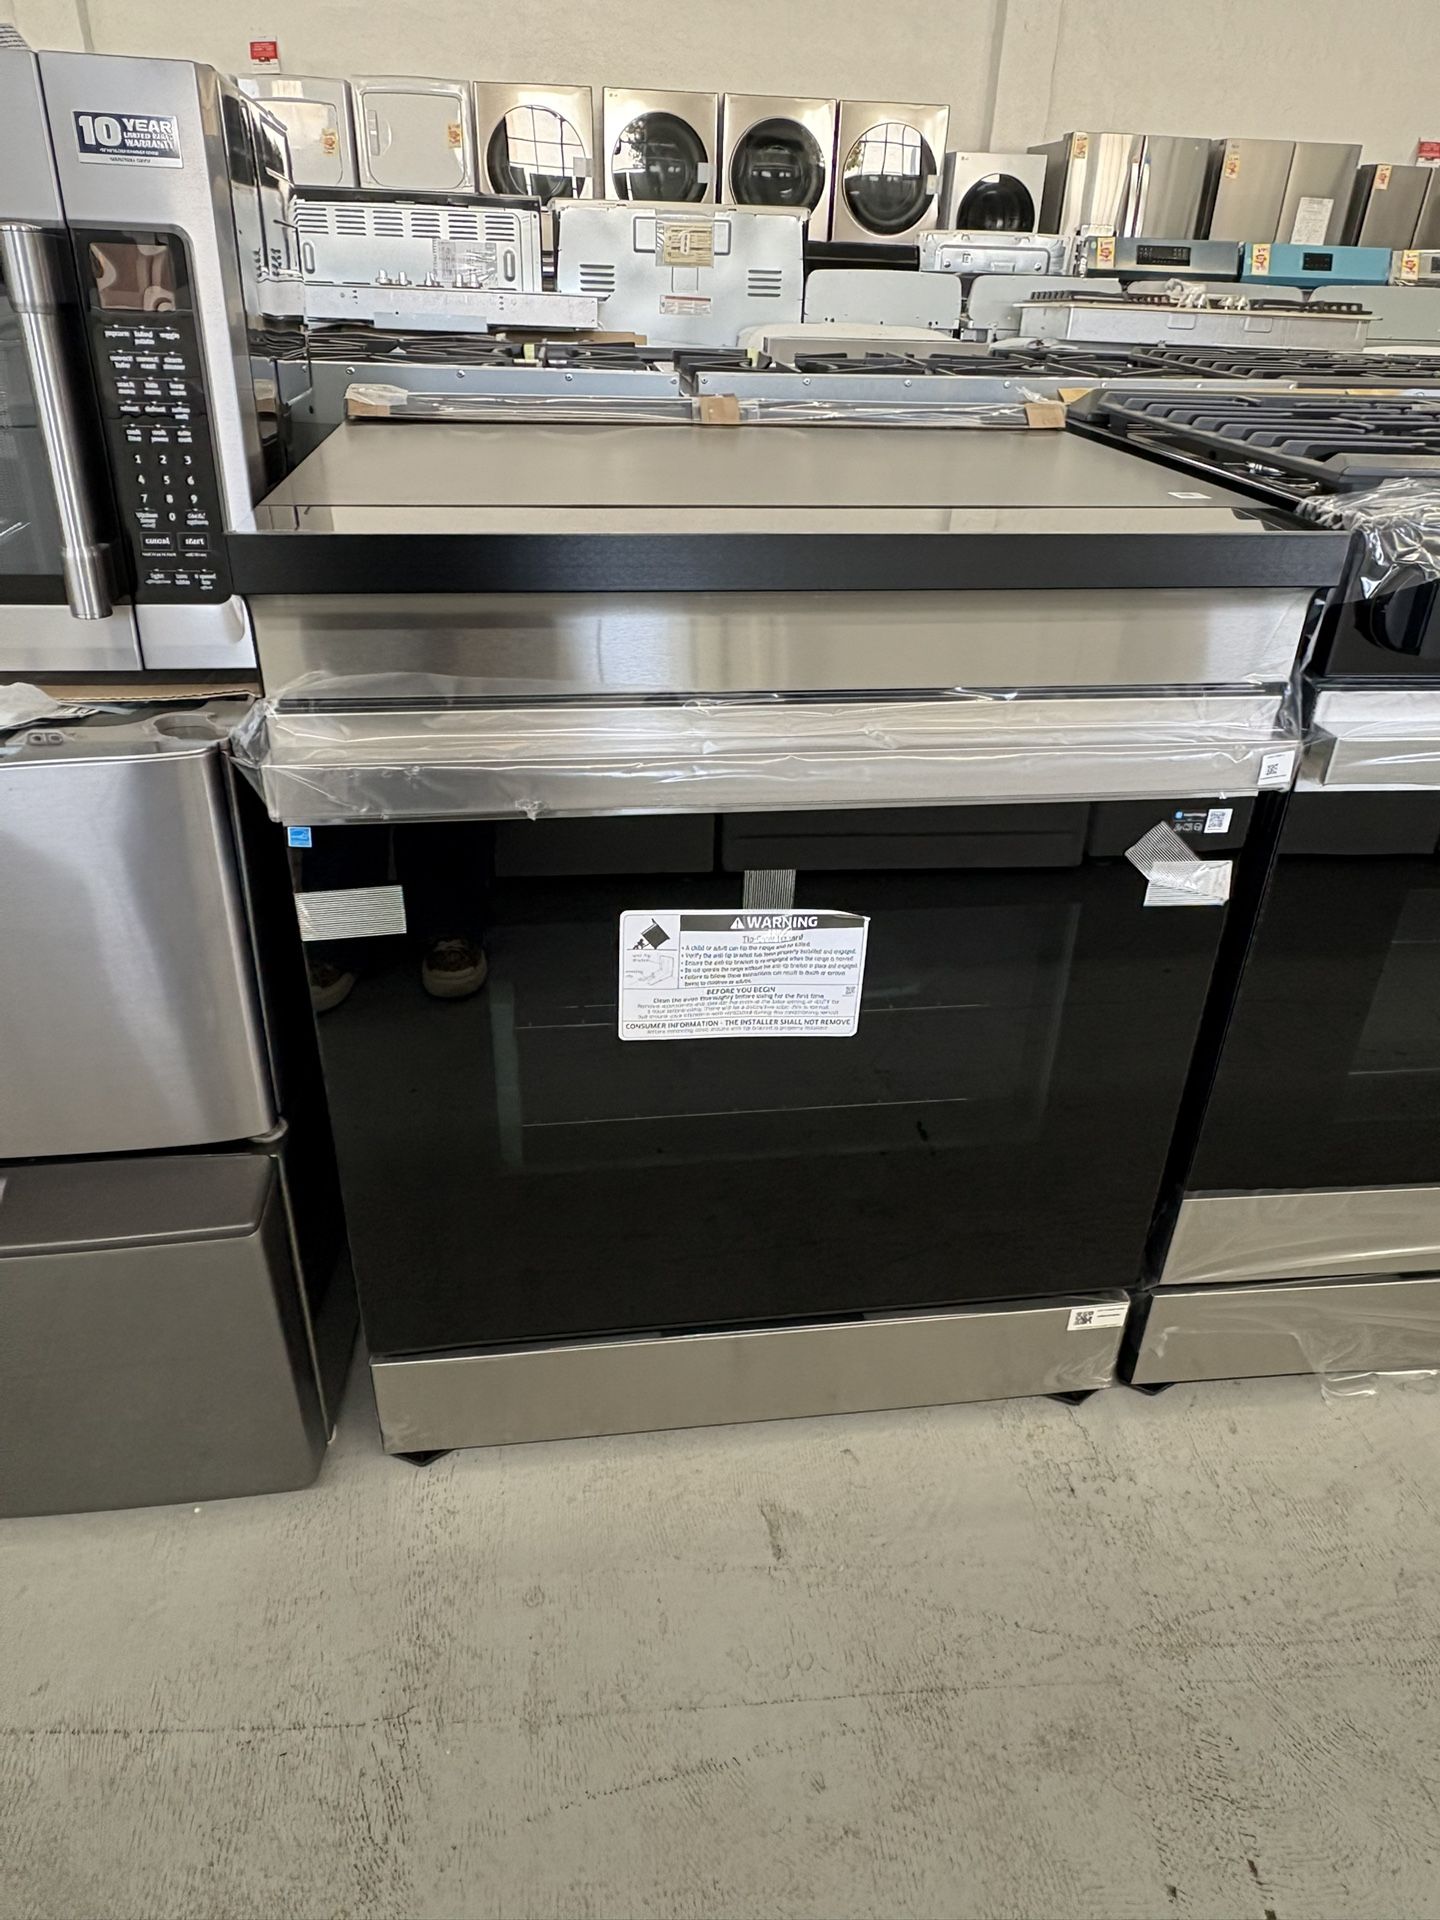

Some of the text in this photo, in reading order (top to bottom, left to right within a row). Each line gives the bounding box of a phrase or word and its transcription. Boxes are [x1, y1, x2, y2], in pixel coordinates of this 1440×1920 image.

[79, 115, 122, 147] 10
[121, 118, 174, 134] YEAR
[135, 454, 142, 465] 1
[159, 454, 168, 465] 2
[183, 455, 192, 466] 3
[137, 474, 145, 485] 4
[163, 475, 170, 485] 5
[187, 475, 195, 486] 6
[140, 493, 148, 504] 7
[190, 494, 198, 504] 9
[168, 512, 176, 521] 0
[145, 537, 171, 545] cancel
[747, 916, 819, 929] WARNING
[626, 1022, 666, 1030] CONSUMER
[667, 1021, 719, 1029] INFORMATION
